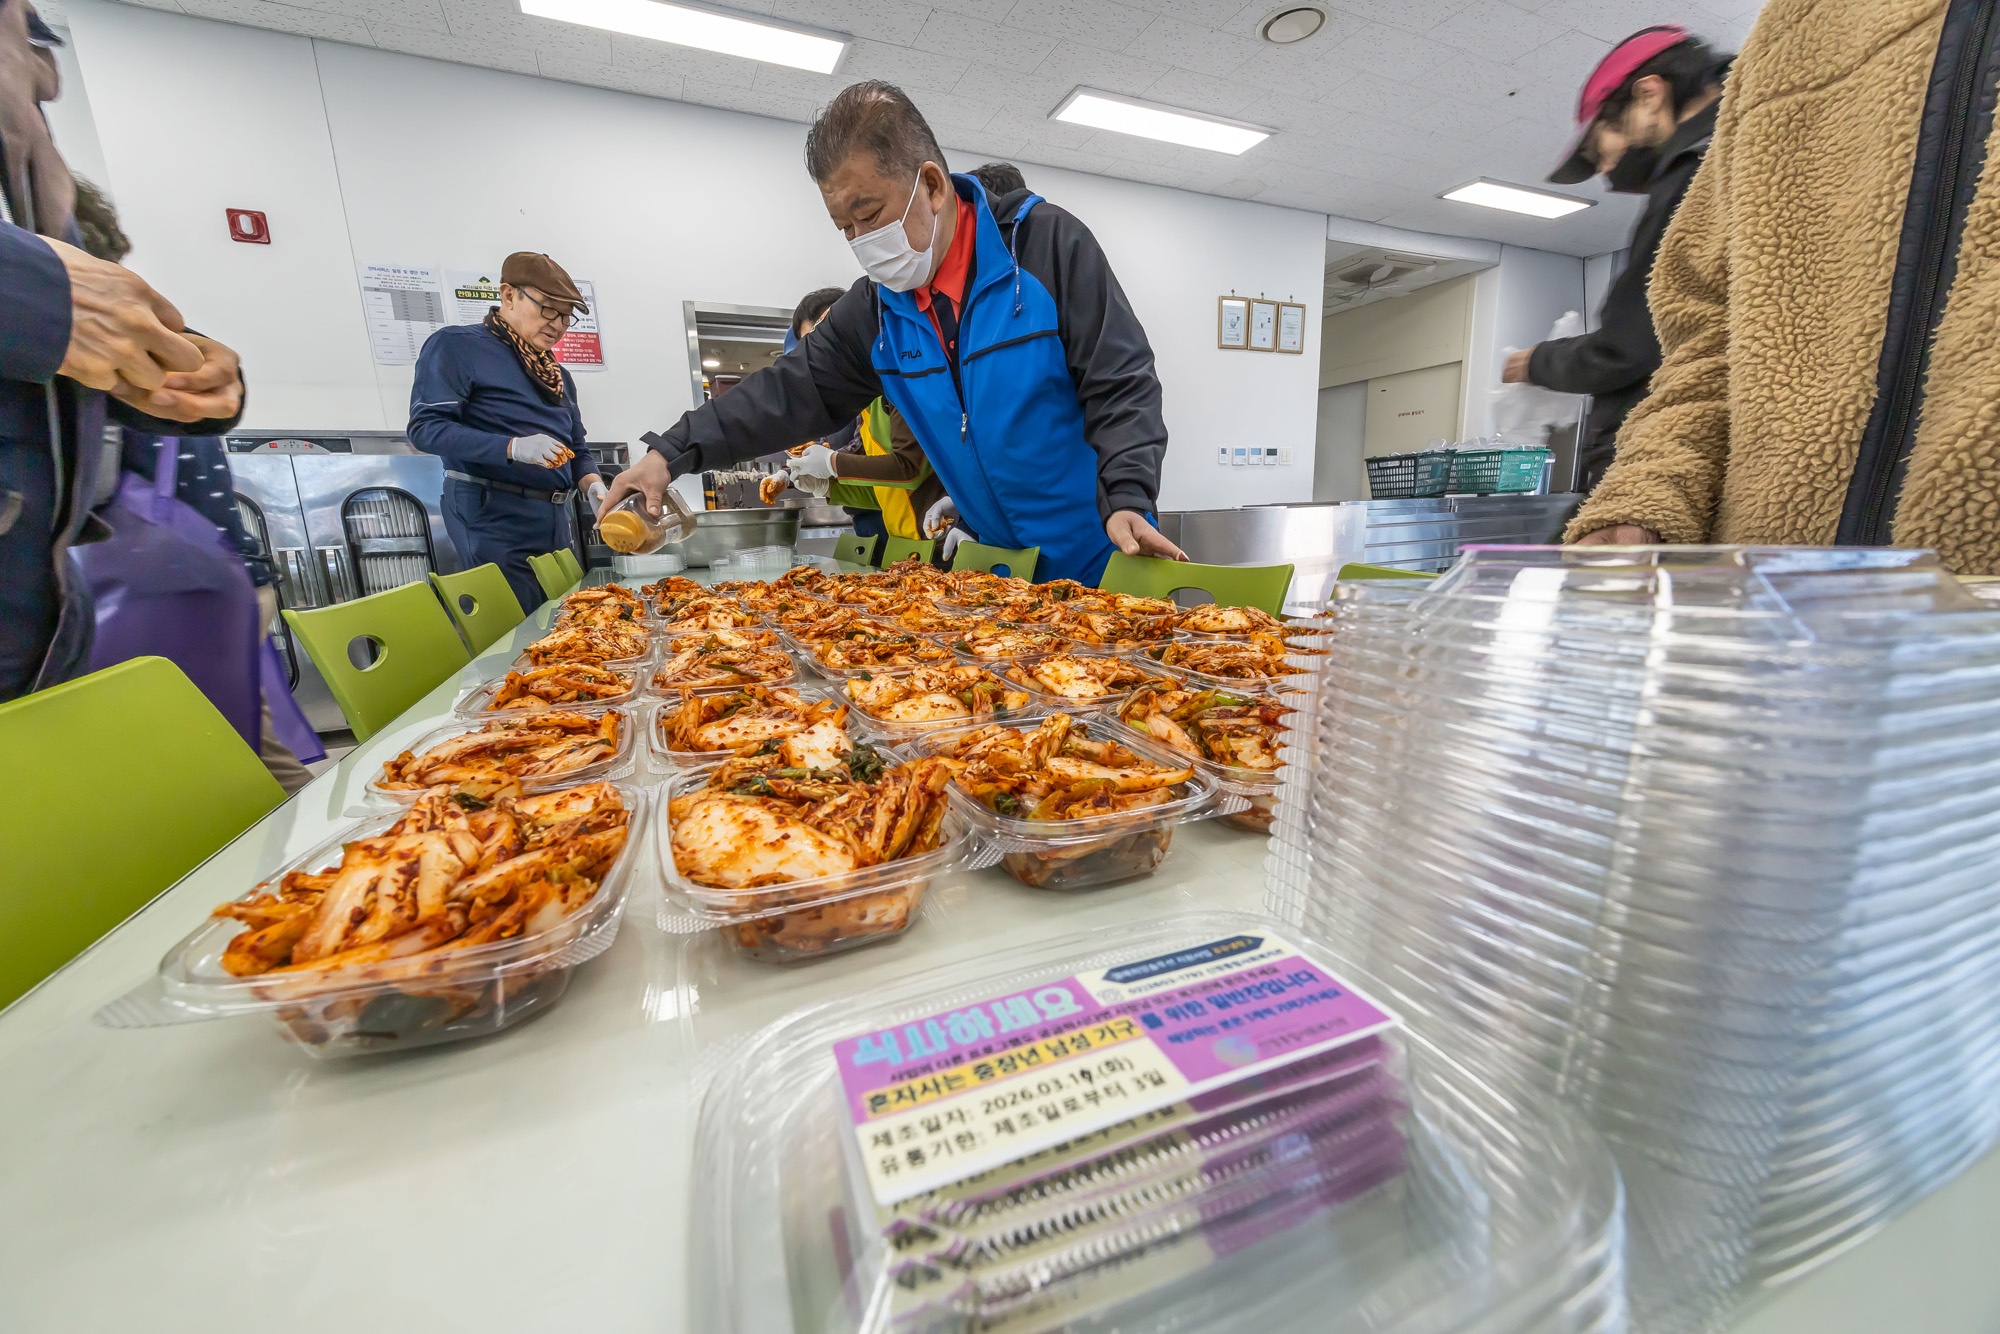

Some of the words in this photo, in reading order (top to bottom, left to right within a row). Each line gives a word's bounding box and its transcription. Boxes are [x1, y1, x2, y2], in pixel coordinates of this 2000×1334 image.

[457, 290, 479, 298] 안마사
[901, 349, 922, 360] FILA
[868, 1073, 967, 1114] 혼자사는
[972, 1047, 1041, 1080] 중장년
[1045, 1032, 1092, 1057] 남성
[1093, 1018, 1138, 1042] 가구
[1165, 1000, 1209, 1022] 위한
[937, 1052, 966, 1069] 다른
[968, 1033, 1035, 1060] 프로그램도
[872, 1107, 974, 1150] 제조일자:
[880, 1130, 987, 1176] 유통기한:
[993, 1083, 1128, 1136] 제조일로부터
[1137, 1068, 1166, 1092] 3일
